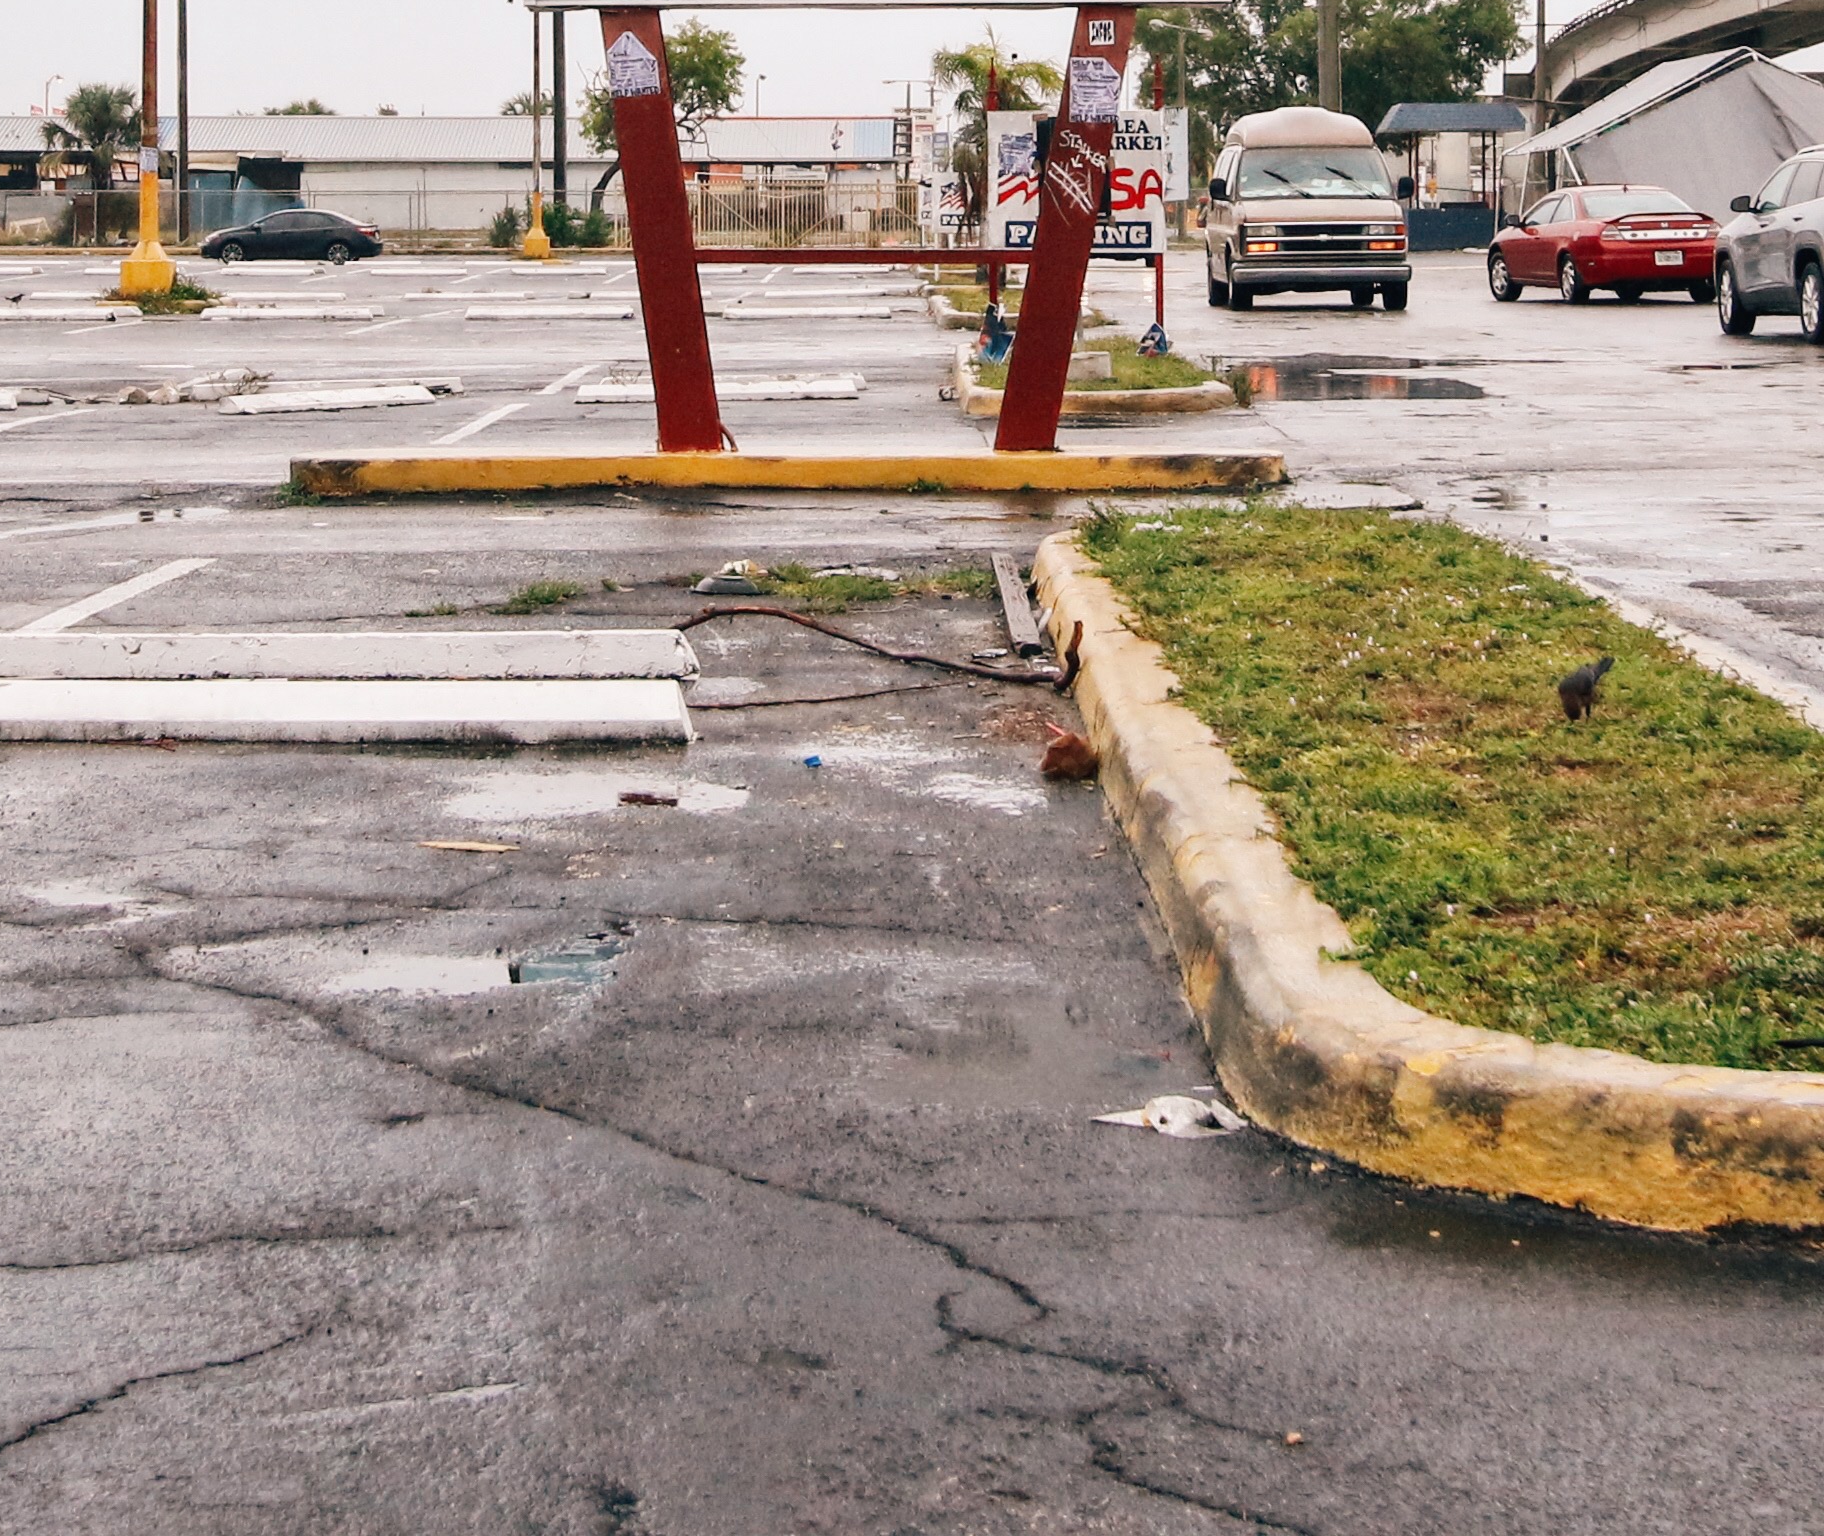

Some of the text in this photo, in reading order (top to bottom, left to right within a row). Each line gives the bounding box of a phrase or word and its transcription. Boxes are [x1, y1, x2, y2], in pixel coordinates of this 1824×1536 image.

[1113, 119, 1150, 134] LEA
[1110, 167, 1163, 211] SA
[1008, 224, 1149, 245] PING
